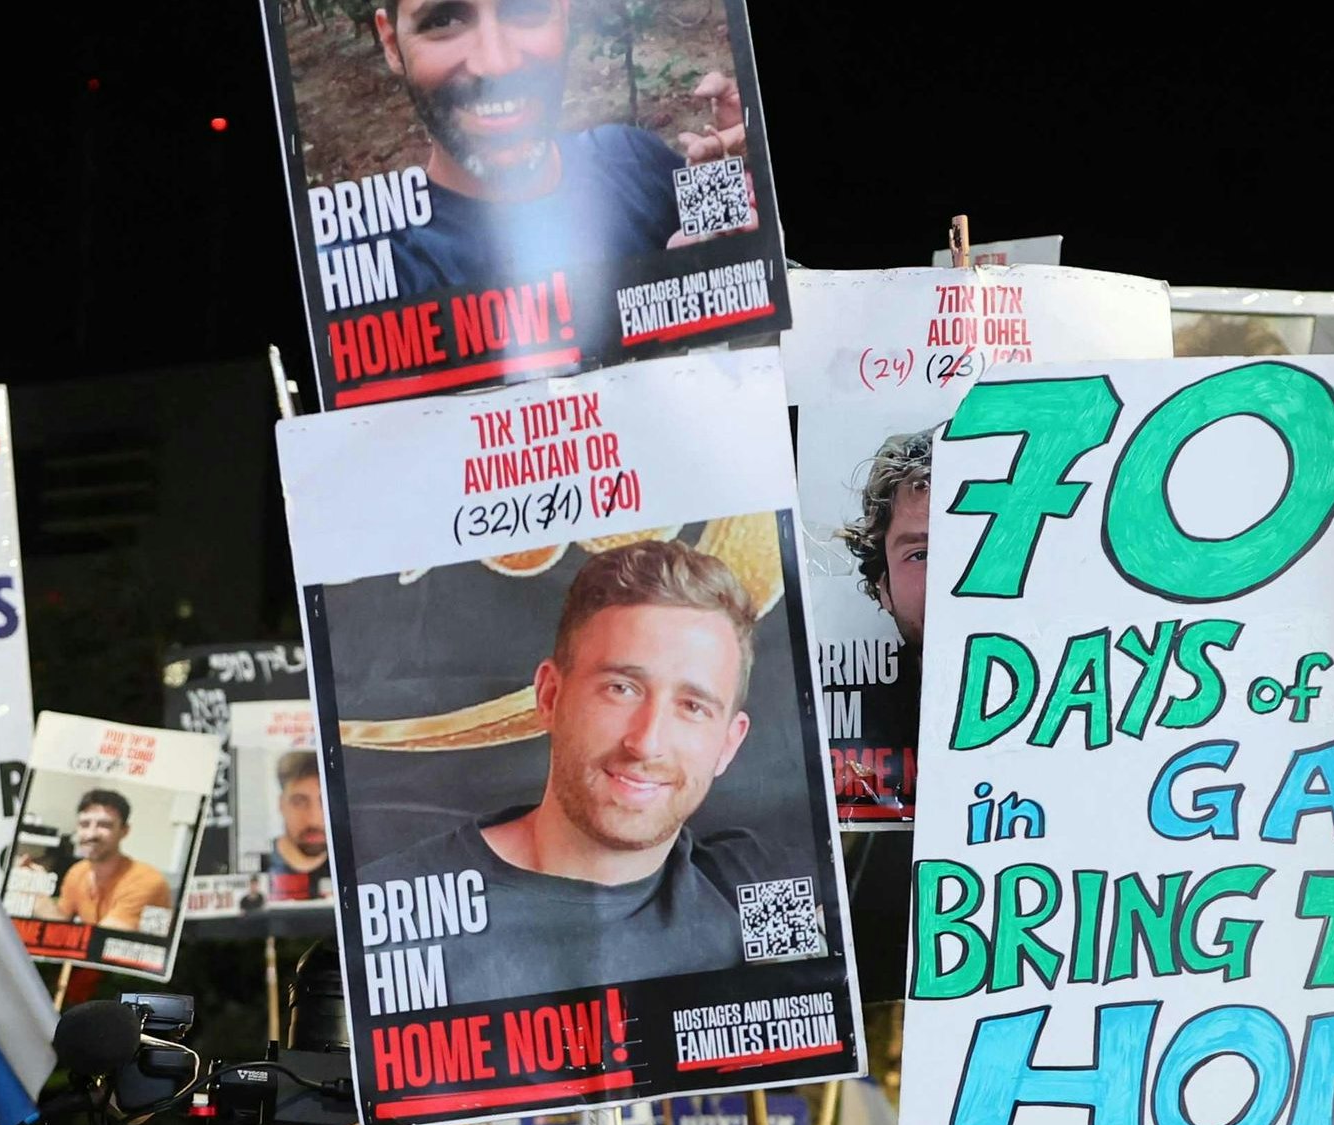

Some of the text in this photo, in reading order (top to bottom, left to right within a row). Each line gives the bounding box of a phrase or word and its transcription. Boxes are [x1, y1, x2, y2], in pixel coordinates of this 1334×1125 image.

[308, 166, 432, 245] BRING
[317, 239, 398, 312] HIM
[617, 260, 765, 311] HOSTAGES AND MISSING
[935, 285, 1022, 317] אלון אהל
[329, 271, 574, 383] HOME NOW!
[621, 285, 770, 338] FAMILIES FORUM
[927, 317, 1032, 347] ALON OHEL
[860, 347, 915, 391] (24)
[471, 392, 602, 450] אבינתן אור
[464, 432, 621, 495] AVINATAN OR
[949, 615, 1244, 752] DAYS
[1246, 651, 1332, 724] of
[822, 691, 861, 739] IM
[830, 748, 893, 796] OME
[966, 783, 1046, 844] in
[357, 869, 489, 947] BRING
[909, 859, 1275, 1002] BRING
[366, 944, 449, 1017] HIM
[372, 988, 630, 1092] HOME NOW!
[672, 992, 834, 1033] HOSTAGES AND MISSING
[675, 1016, 837, 1065] FAMILIES FORUM
